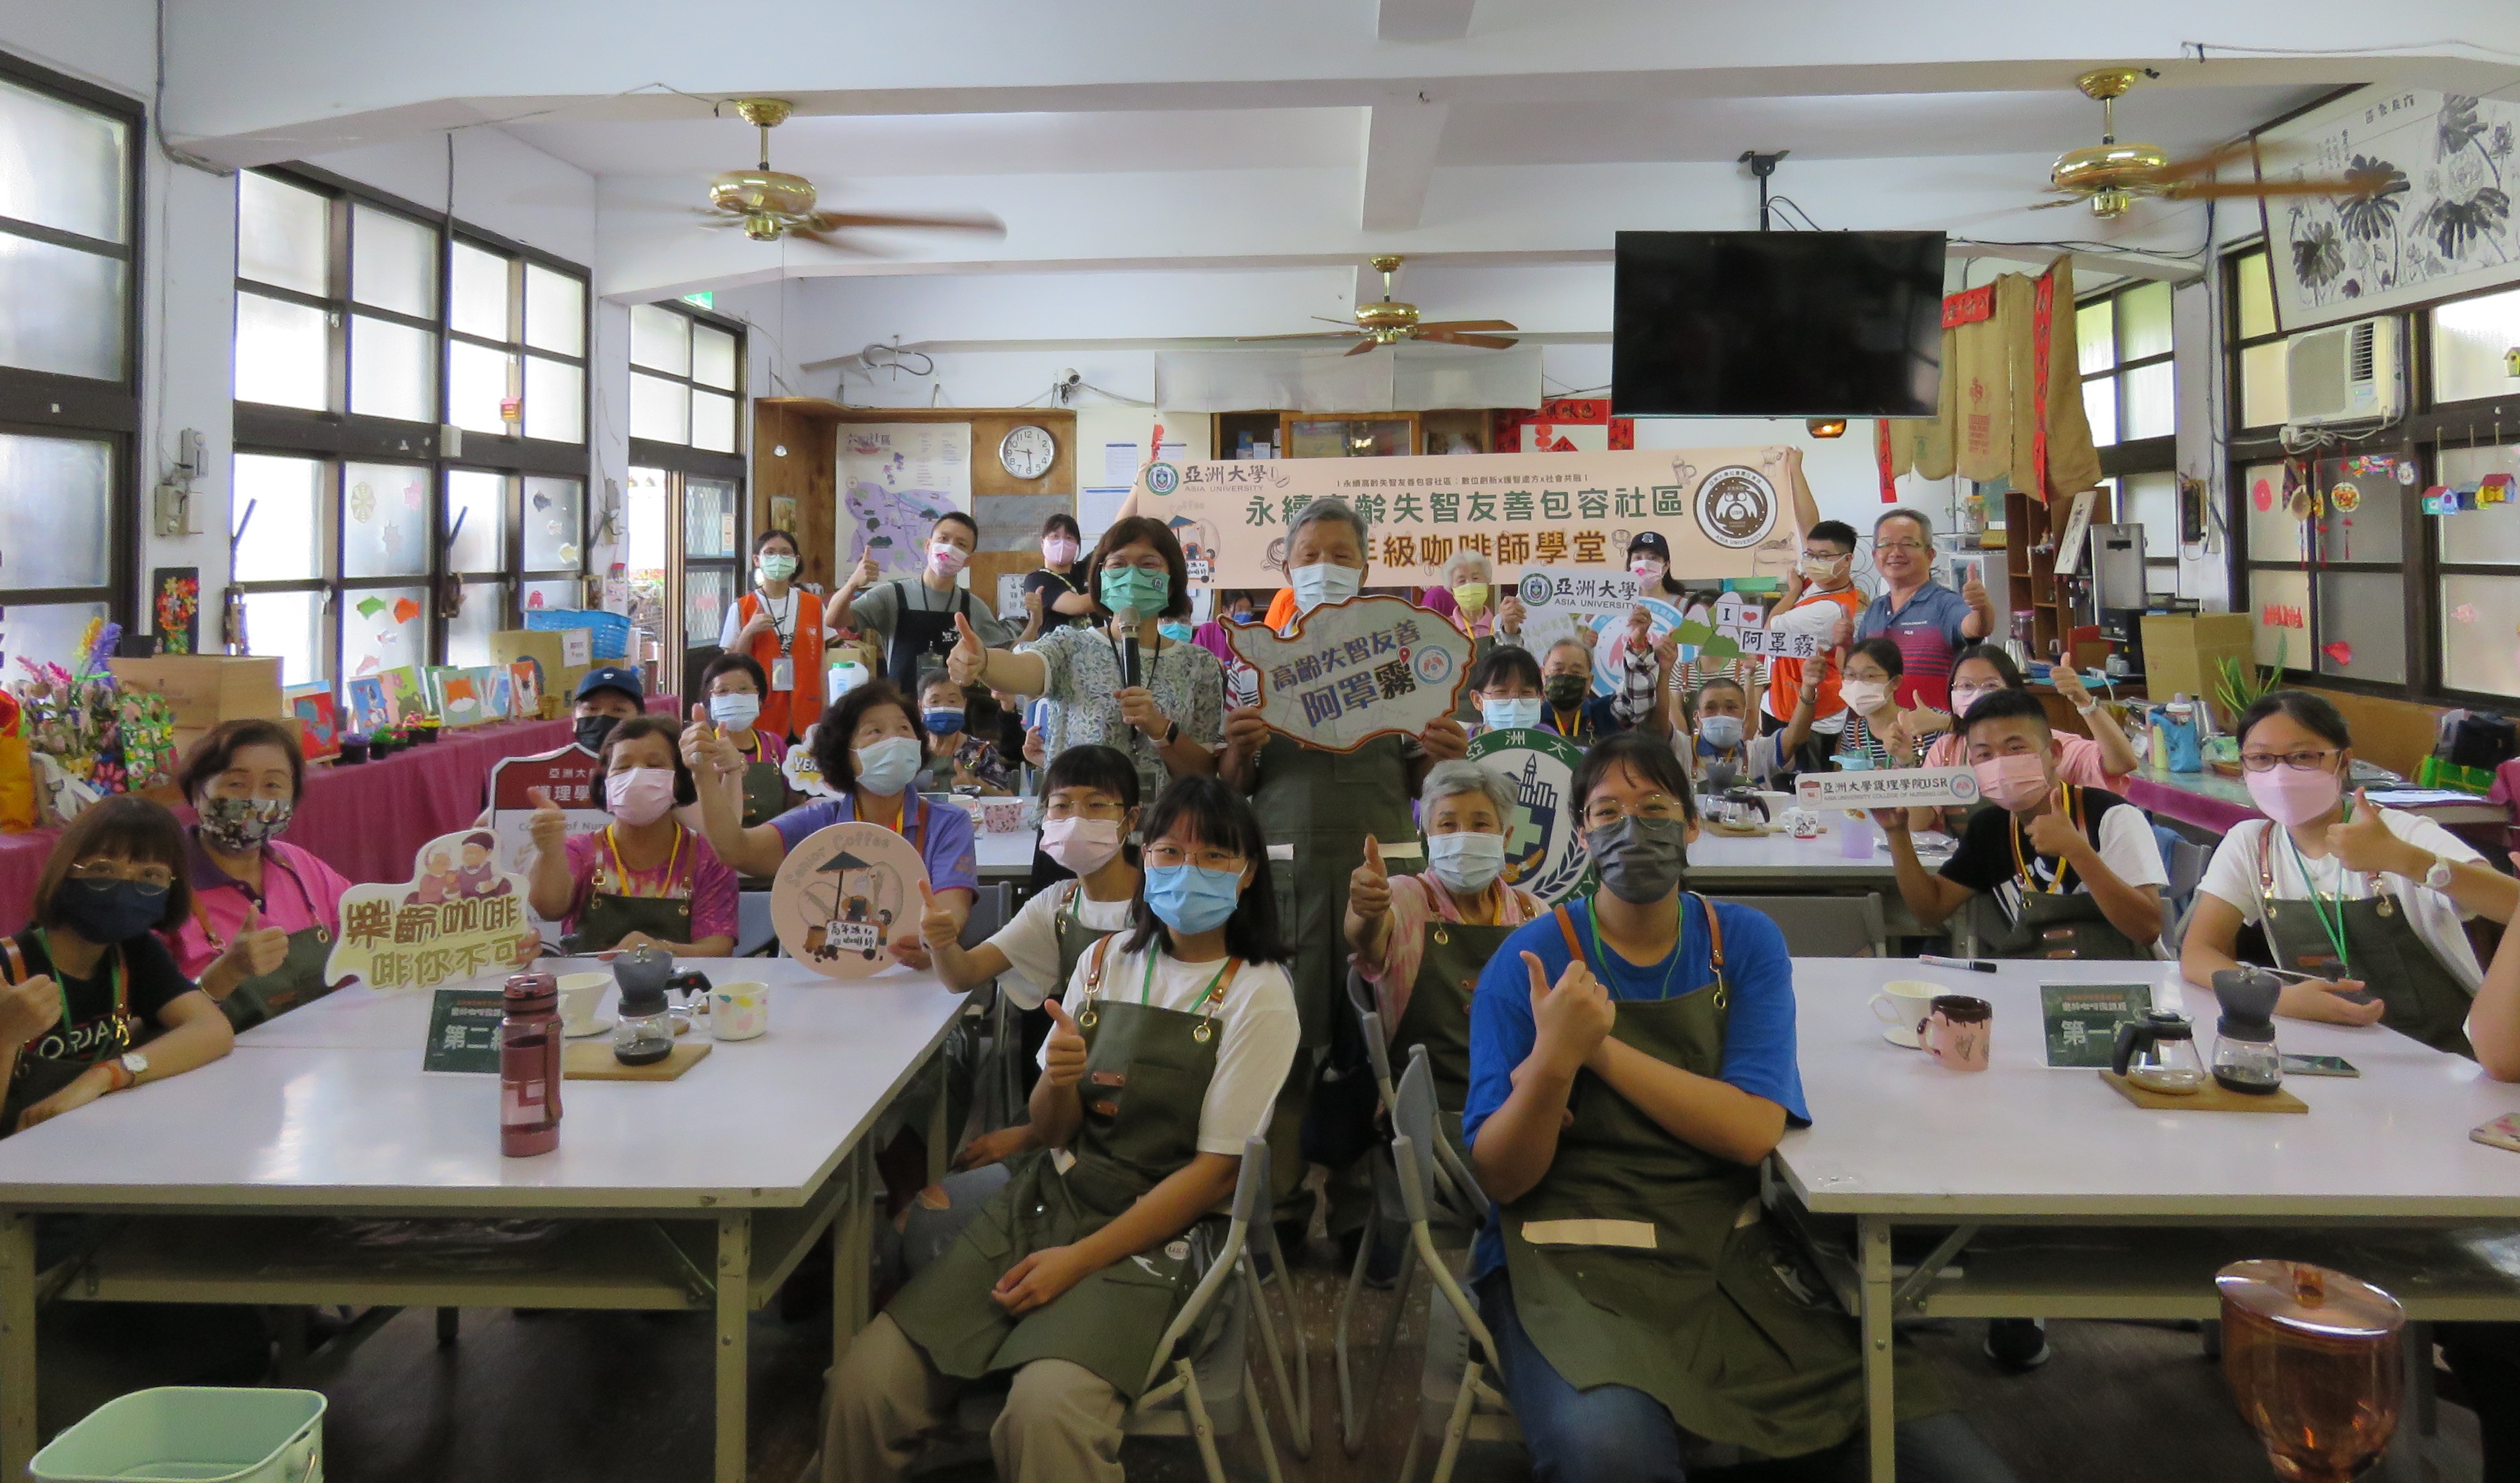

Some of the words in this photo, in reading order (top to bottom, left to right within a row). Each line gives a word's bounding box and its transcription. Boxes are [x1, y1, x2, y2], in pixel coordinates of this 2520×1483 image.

[1044, 448, 1050, 456] 3
[1183, 465, 1266, 484] 亞洲大學
[1246, 483, 1684, 526] 永續齡失智友善包容社區
[1554, 577, 1637, 601] 亞洲大學
[1555, 598, 1576, 606] ASIA
[1581, 599, 1637, 610] UNIVERSITY
[1723, 608, 1731, 621] I
[1269, 619, 1422, 692] 高齡失智友善
[1742, 630, 1815, 657] 阿罩霧
[1300, 658, 1417, 728] 阿罩霧
[346, 896, 518, 949] 樂齡咖啡
